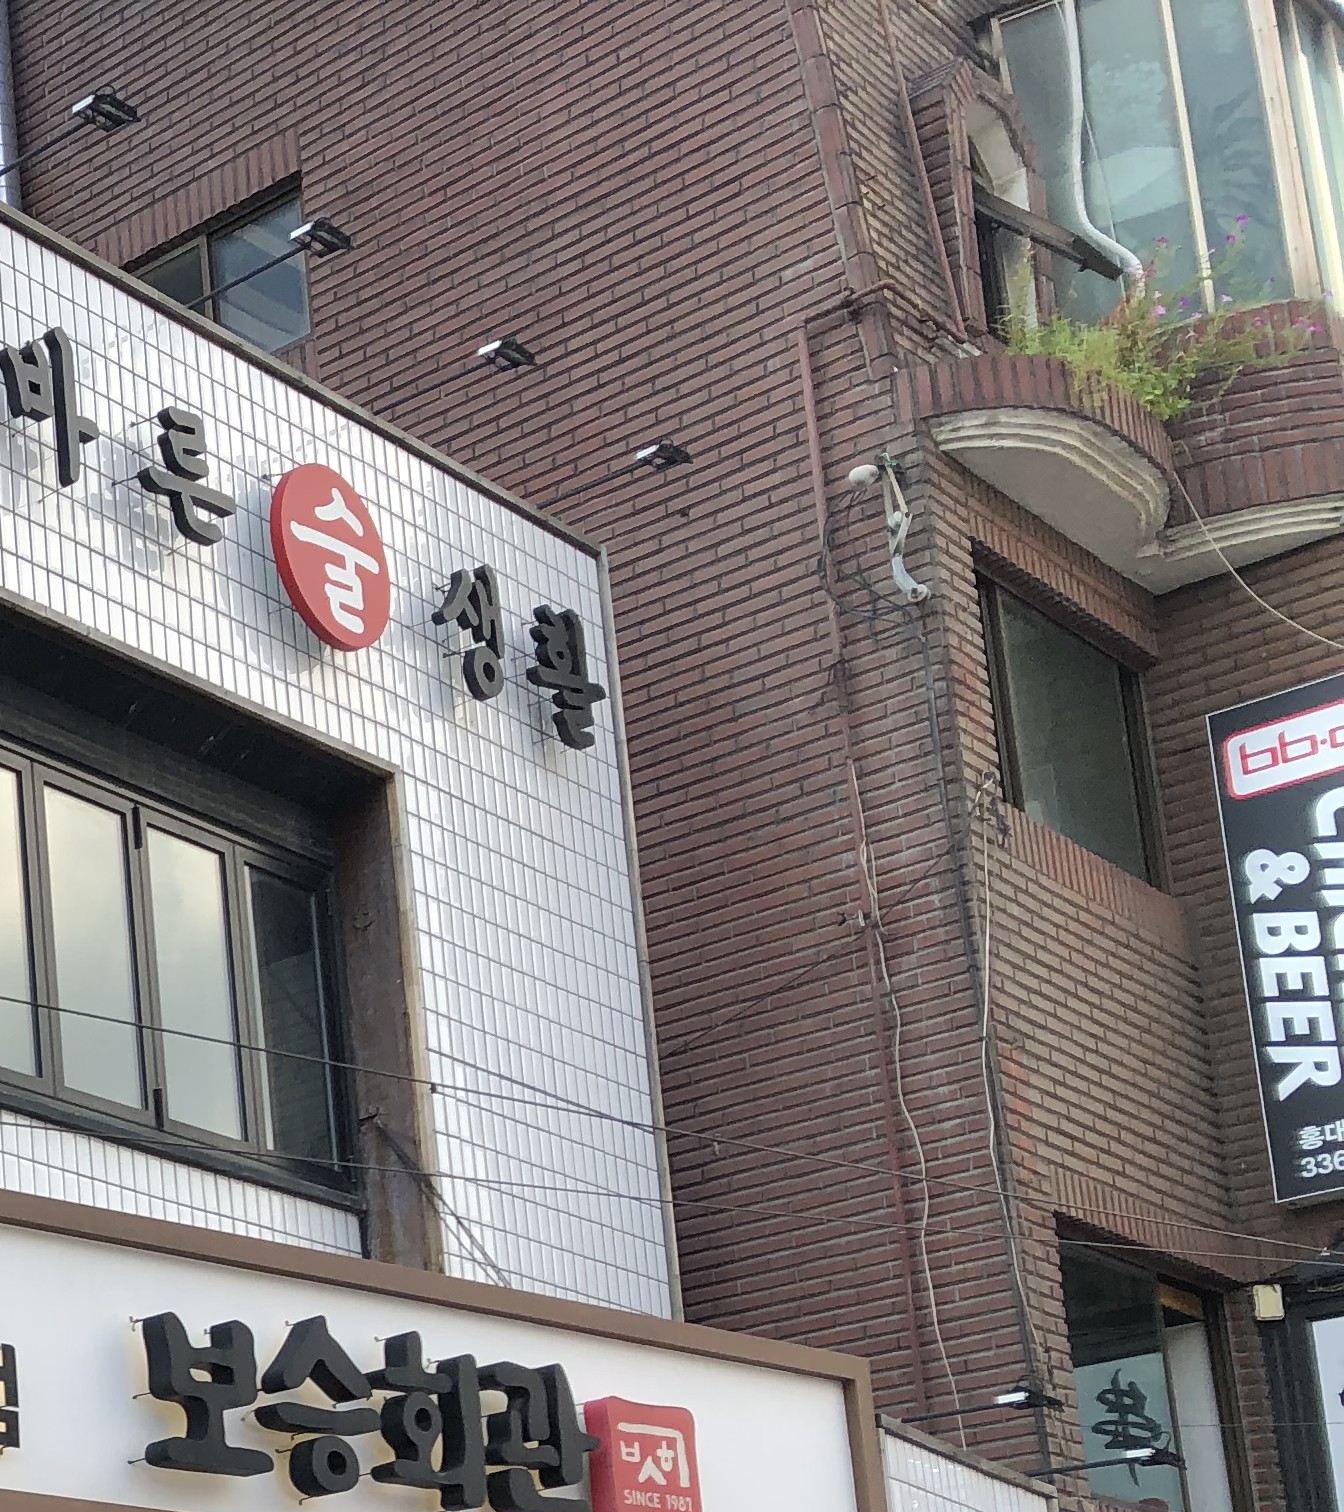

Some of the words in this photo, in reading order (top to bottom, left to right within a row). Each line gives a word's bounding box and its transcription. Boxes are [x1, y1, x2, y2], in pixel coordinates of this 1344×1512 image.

[291, 484, 380, 636] 술
[431, 564, 607, 751] 생활
[1252, 911, 1342, 1101] BEER
[623, 1488, 662, 1509] SINCE
[665, 1493, 694, 1512] 1987
